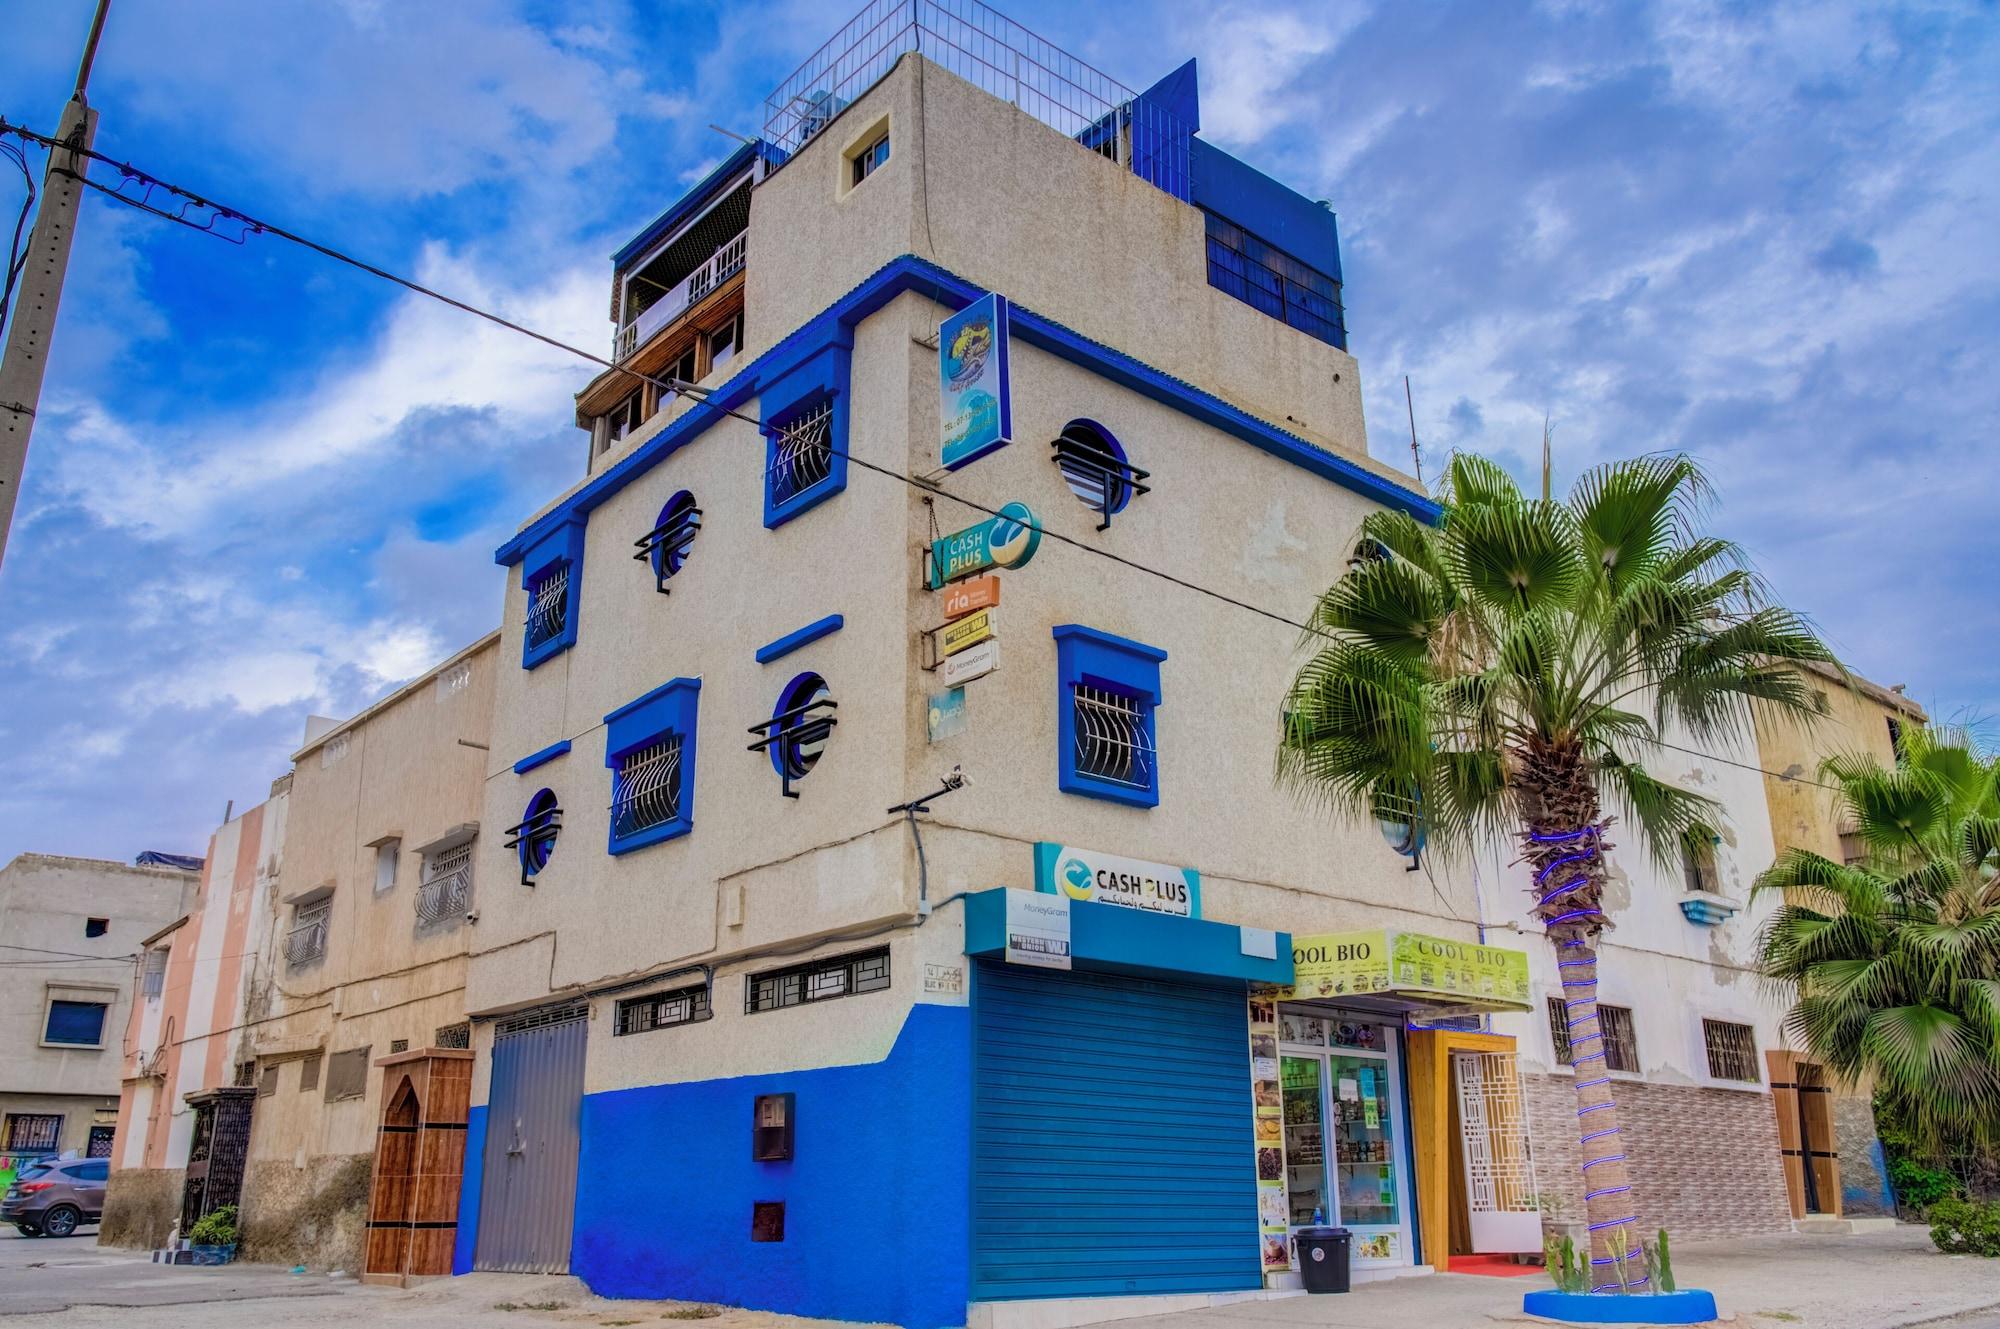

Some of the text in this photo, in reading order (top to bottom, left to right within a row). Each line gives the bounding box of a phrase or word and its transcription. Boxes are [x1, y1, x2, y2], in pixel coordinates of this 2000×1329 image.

[950, 531, 983, 555] CASH
[950, 548, 982, 572] PLUS
[947, 591, 969, 612] ria
[1097, 870, 1187, 904] CASH PLUS
[1024, 904, 1068, 917] MoneyGram
[1292, 943, 1370, 965] OOL BIO
[1418, 941, 1469, 961] COOL
[1476, 949, 1505, 967] BIO
